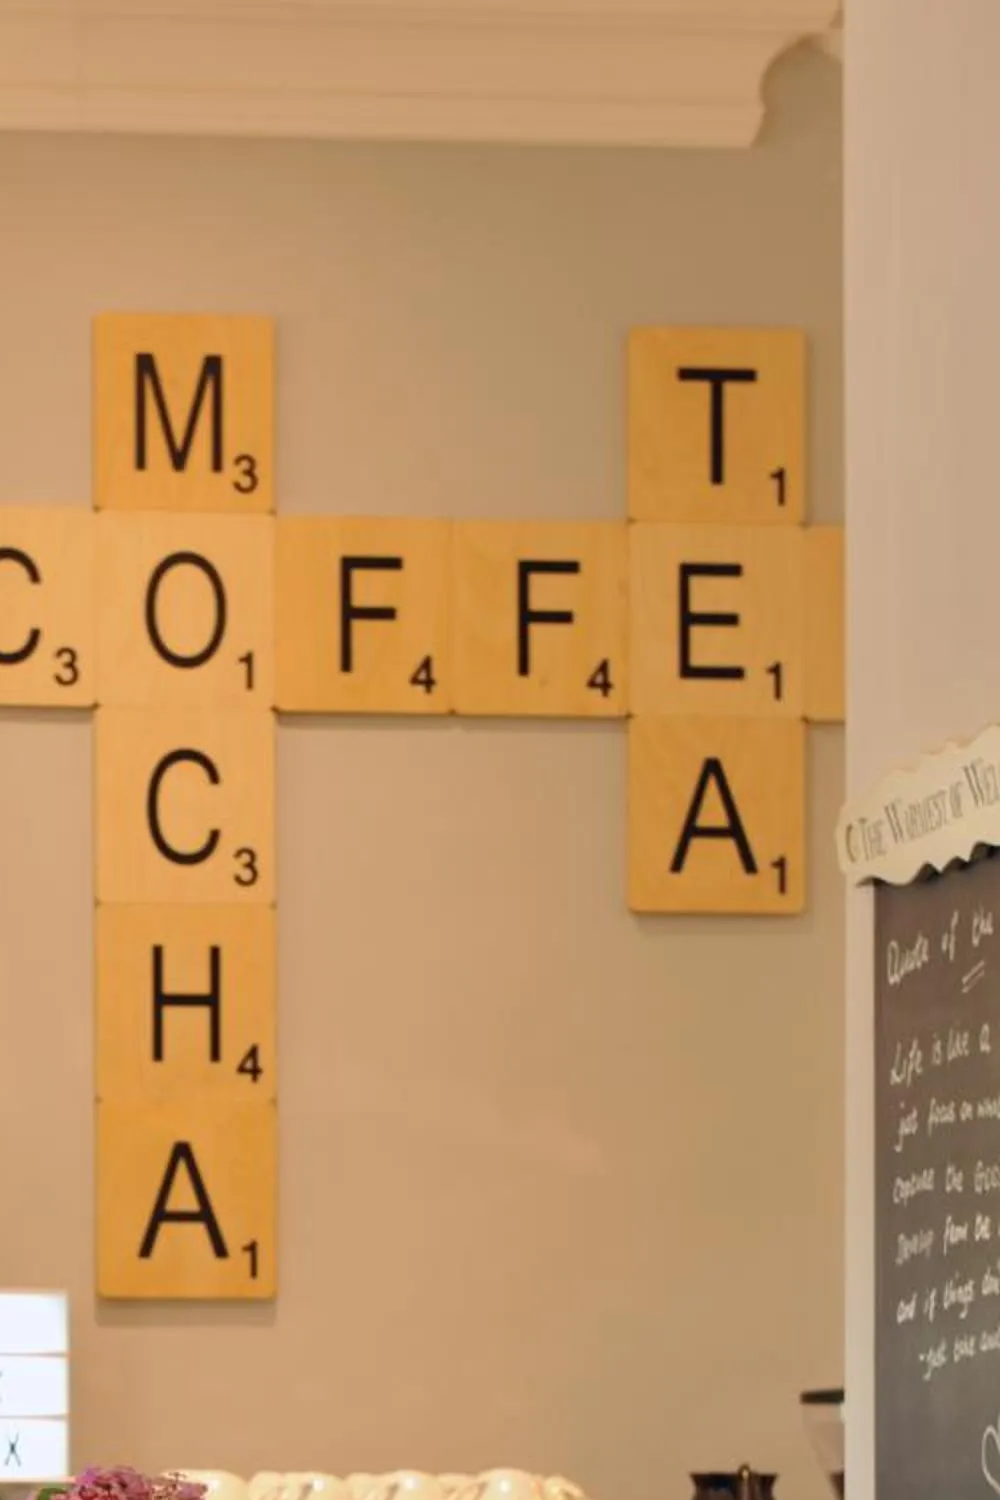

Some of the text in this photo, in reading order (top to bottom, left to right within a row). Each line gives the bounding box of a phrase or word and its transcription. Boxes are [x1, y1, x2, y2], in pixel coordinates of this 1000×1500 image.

[232, 454, 259, 494] 3
[769, 468, 787, 505] 1
[669, 367, 758, 875] TEA
[53, 647, 80, 686] 3
[238, 651, 255, 690] 1
[410, 655, 437, 694] 4
[587, 659, 614, 697] 4
[766, 662, 783, 700] 1
[134, 353, 230, 1259] MOCHA
[233, 847, 259, 887] 3
[771, 857, 788, 894] 1
[941, 910, 959, 961] of
[972, 904, 994, 948] the
[236, 1044, 263, 1083] 4
[889, 1024, 992, 1087] Life is like a
[894, 1101, 919, 1152] just
[928, 1097, 956, 1137] focus
[959, 1100, 973, 1121] on
[943, 1215, 969, 1257] from
[241, 1241, 260, 1279] 1
[896, 1292, 918, 1324] and
[923, 1287, 938, 1324] if
[943, 1271, 975, 1320] things
